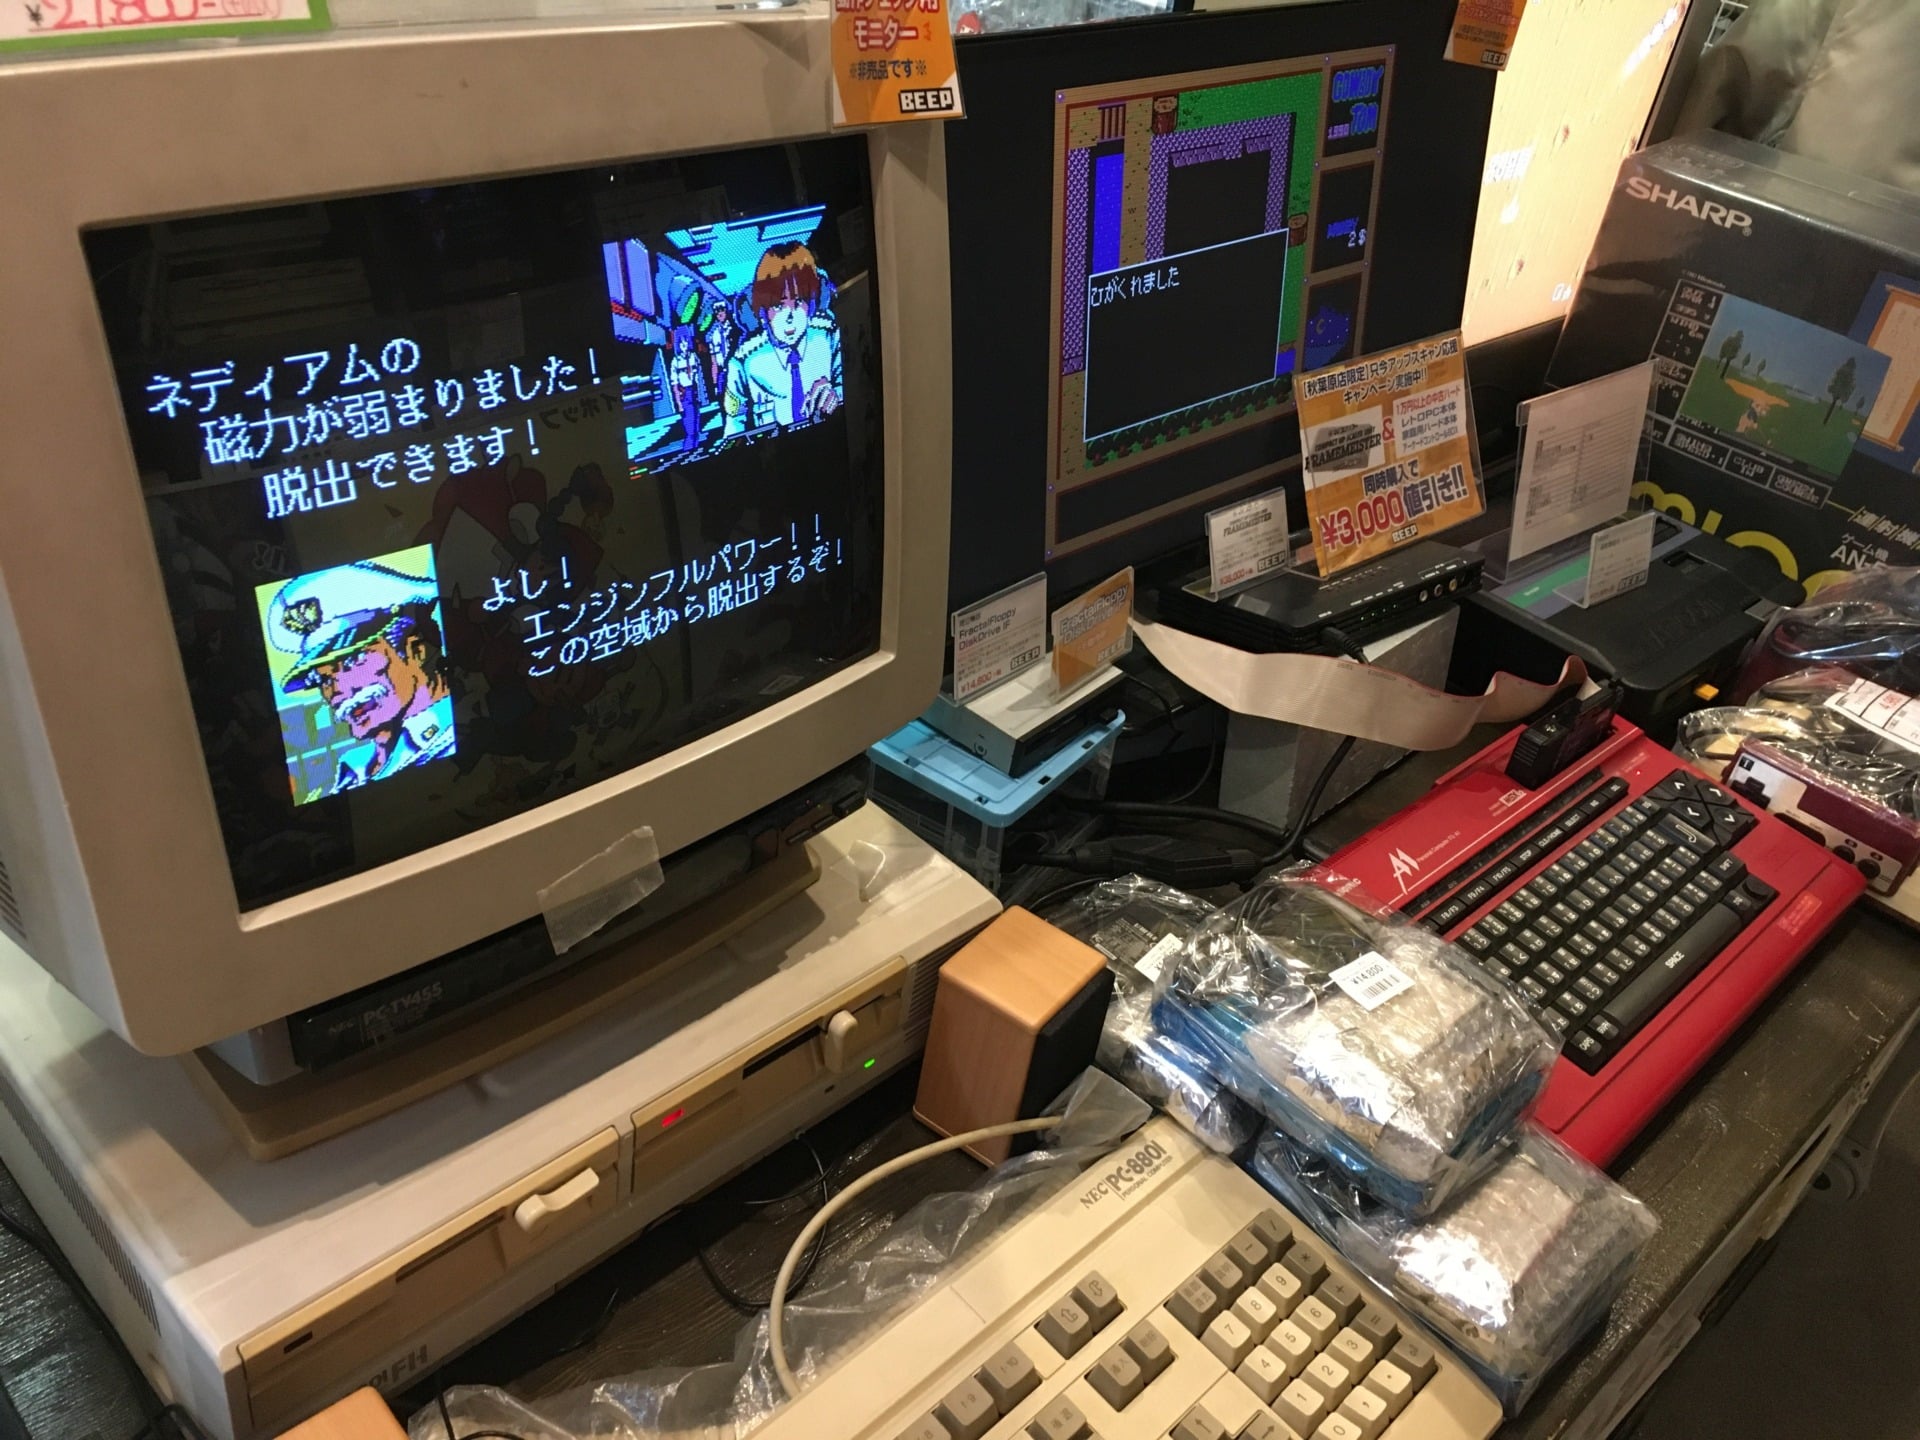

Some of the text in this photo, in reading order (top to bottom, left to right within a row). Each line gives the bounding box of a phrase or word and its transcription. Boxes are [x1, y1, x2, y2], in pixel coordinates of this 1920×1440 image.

[853, 16, 919, 50] モニター
[900, 89, 953, 112] BEEP
[1625, 176, 1753, 231] SHARP
[1090, 266, 1180, 307] ひがくれました
[146, 337, 421, 418] ネディアムの
[1382, 416, 1395, 443] &
[1305, 433, 1382, 471] FRAMEMEISTER
[1391, 525, 1418, 544] BEEP
[1258, 552, 1286, 573] BEEP
[959, 606, 1017, 639] FractalFloppy
[1664, 951, 1685, 969] SPACE
[1079, 1139, 1168, 1210] NEC PC-8801
